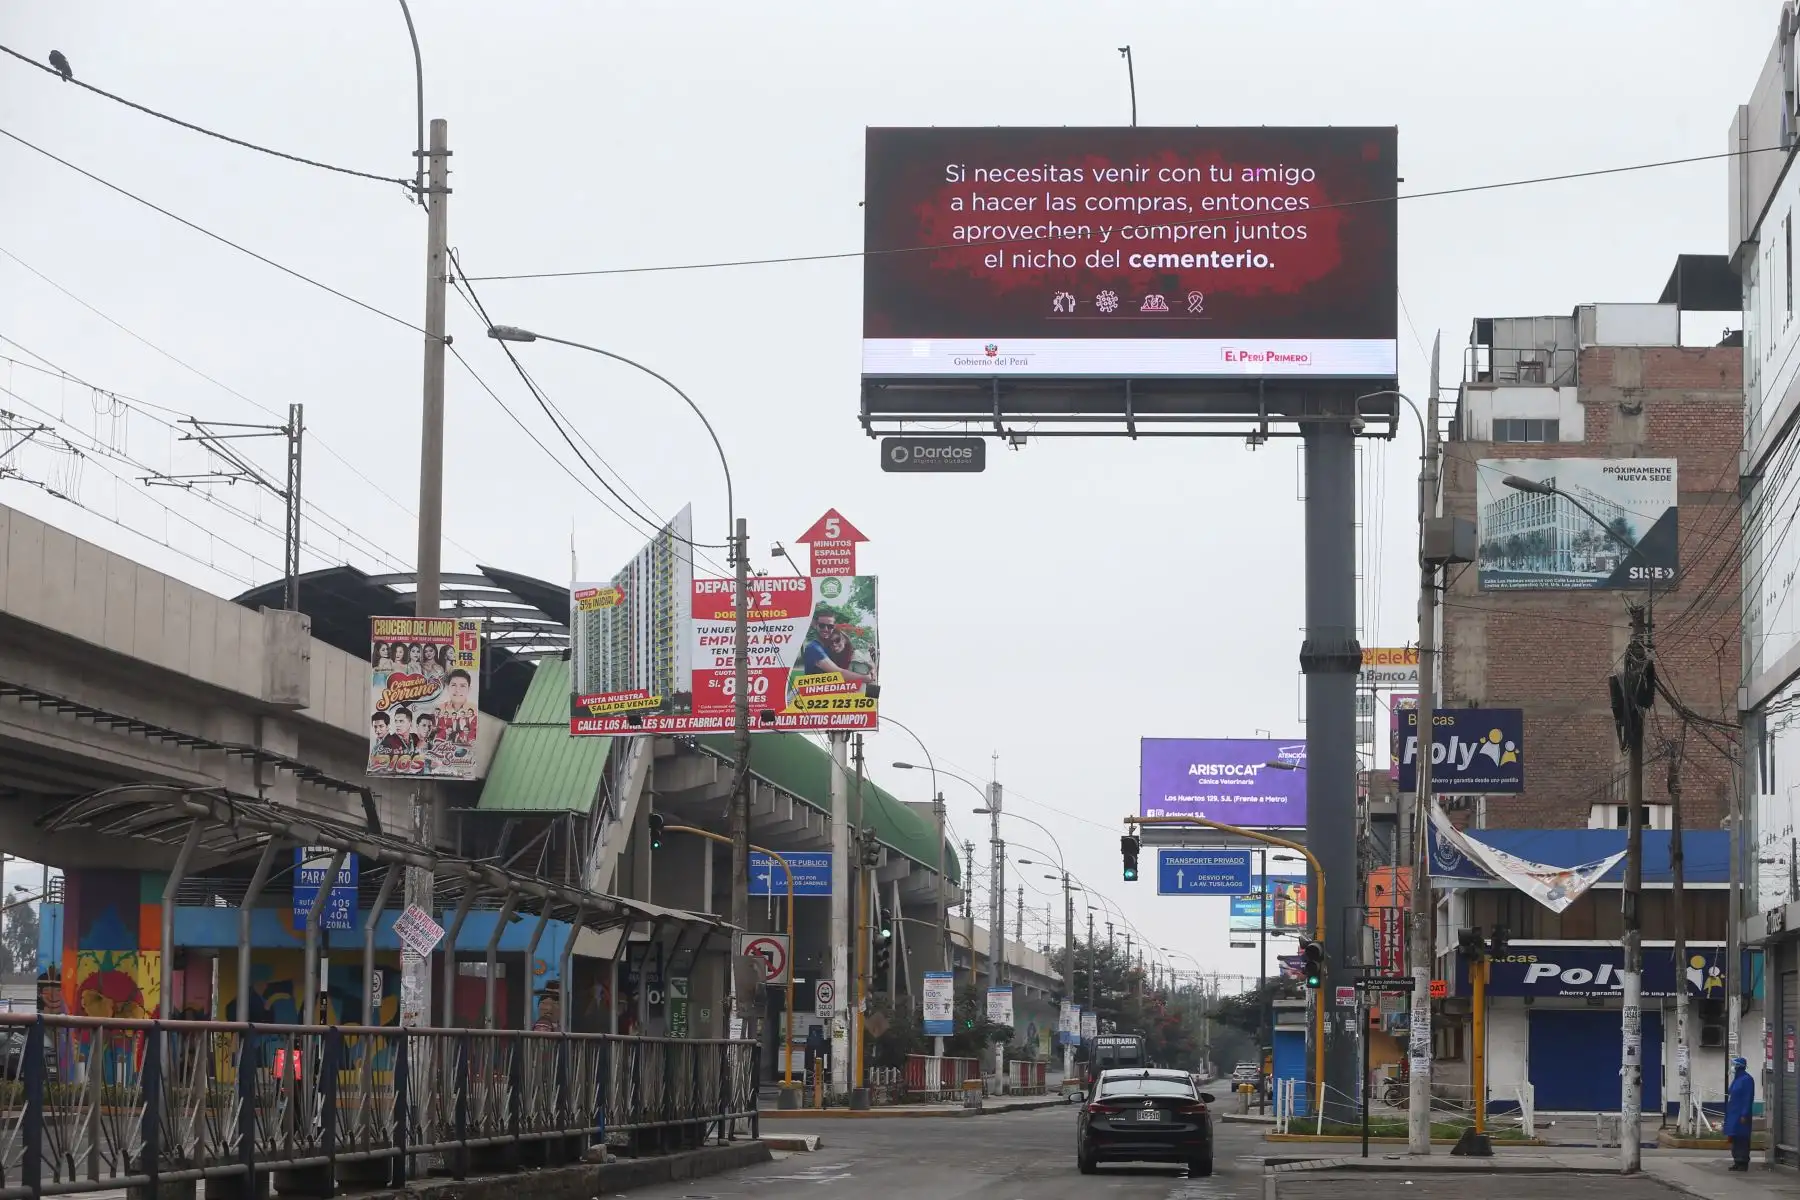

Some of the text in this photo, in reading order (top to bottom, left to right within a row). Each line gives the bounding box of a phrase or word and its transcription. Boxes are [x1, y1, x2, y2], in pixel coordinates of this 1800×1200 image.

[945, 164, 1316, 186] Si necesitas venir con tu amigo
[950, 192, 1310, 214] a hacer las compras, entonces
[952, 221, 1308, 243] aprovechen y compren juntos
[984, 249, 1276, 268] el nicho del cementerio.
[953, 357, 1028, 366] Gobierno del Perú
[913, 445, 973, 459] Dardos
[1602, 465, 1672, 474] PRÓXIMAMENTE
[1617, 474, 1672, 482] NUEVA SEDE
[824, 518, 841, 539] 5
[813, 540, 852, 548] MINUTOS
[1629, 566, 1663, 580] SISE
[695, 579, 806, 593] DEPARAMENTOS
[747, 597, 754, 609] y
[759, 592, 772, 606] 2
[714, 609, 788, 619] DORITORIOS
[374, 620, 453, 637] CRUCERO DEL AMOR
[762, 634, 792, 644] HOY
[715, 656, 776, 667] DEA YA!
[797, 675, 838, 686] ENTREGA
[1366, 670, 1406, 681] Banco
[805, 682, 857, 694] INMEDIATA
[376, 683, 438, 711] Serrano
[582, 692, 645, 705] VISITA NUESTRA
[806, 698, 875, 709] 922 123 150
[591, 704, 612, 712] SALA
[626, 698, 659, 708] VENTAS
[577, 720, 602, 731] CALLE
[604, 719, 620, 730] LOS
[659, 718, 674, 729] S/N
[676, 718, 687, 728] EX
[688, 716, 723, 728] FABRICA
[799, 714, 829, 726] TOTTUS
[830, 713, 868, 726] CAMPOY)
[1408, 713, 1455, 726] Bcas
[1402, 735, 1478, 771] Poly
[1188, 763, 1265, 776] ARISTOCAT
[1164, 794, 1177, 802] Los
[1178, 794, 1205, 802] Huertos
[1265, 795, 1288, 803] Metro)
[326, 920, 352, 929] ZONAL
